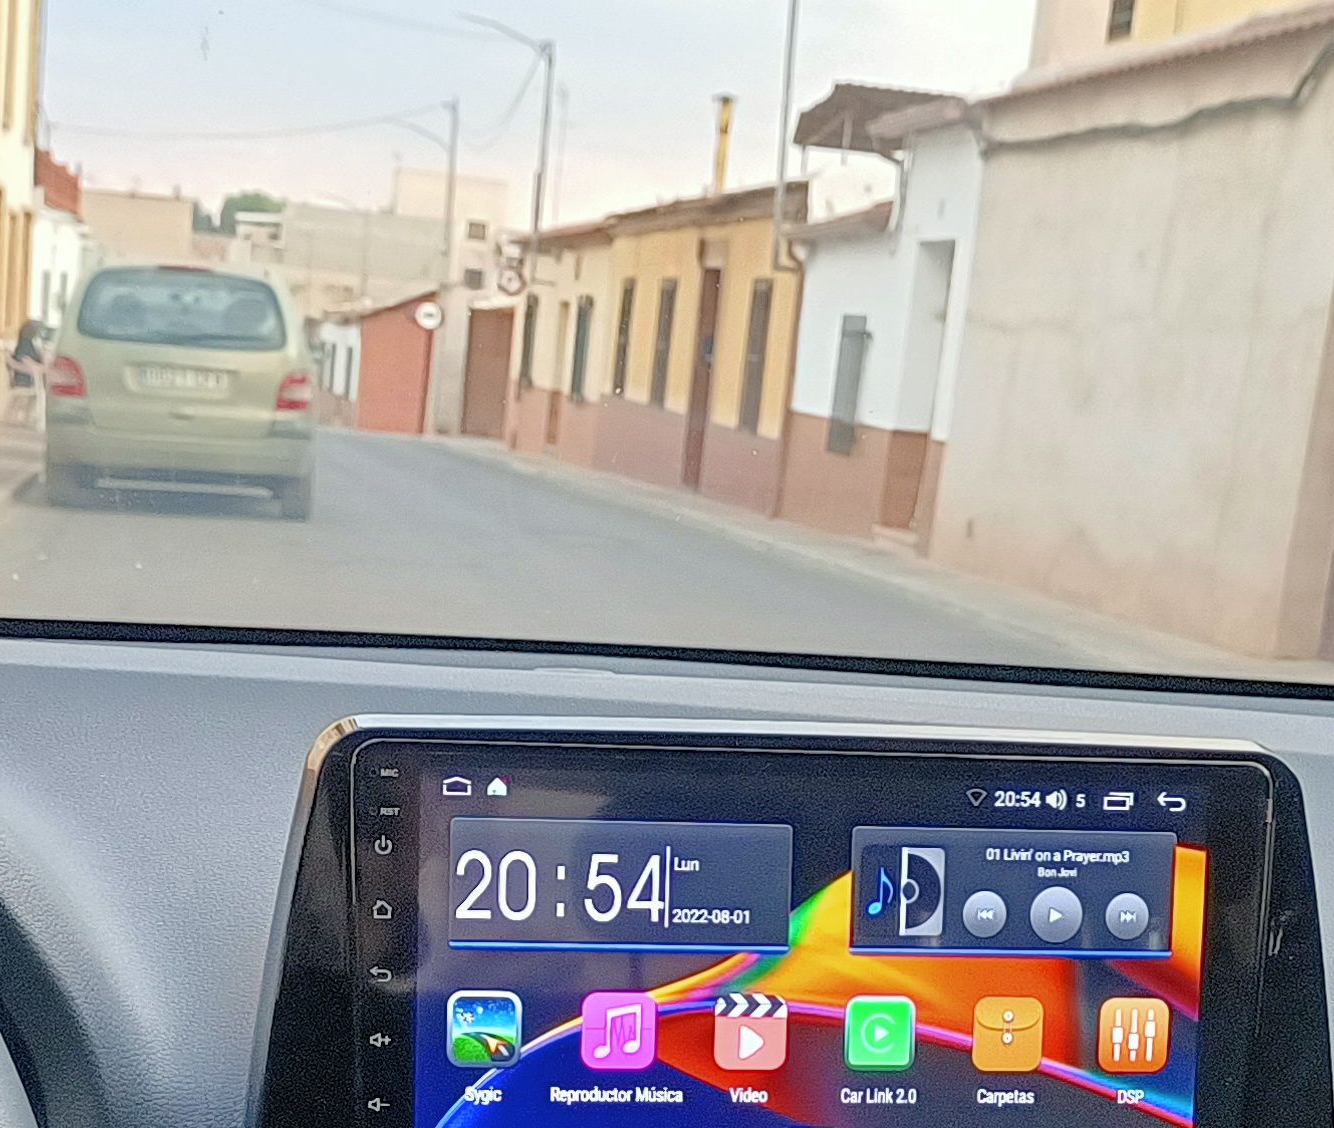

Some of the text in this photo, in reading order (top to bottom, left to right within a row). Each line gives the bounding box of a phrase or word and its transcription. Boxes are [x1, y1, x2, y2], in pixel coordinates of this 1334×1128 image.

[380, 768, 399, 778] MIC
[994, 791, 1085, 808] 20:54 5
[380, 807, 400, 816] RST
[673, 857, 700, 872] Lun
[986, 848, 1001, 861] 01
[1035, 852, 1051, 862] on
[1053, 853, 1061, 862] a
[1063, 850, 1130, 865] Prayer.mp3
[1037, 867, 1077, 878] Bon Jovi
[672, 908, 750, 924] 2022-08-01
[464, 1086, 502, 1106] Sygic
[550, 1086, 683, 1105] Reproductor Música
[729, 1087, 768, 1103] Video
[840, 1087, 917, 1104] Car Link 2.0
[976, 1088, 1035, 1107] Carpetas
[1116, 1089, 1145, 1104] DSP
